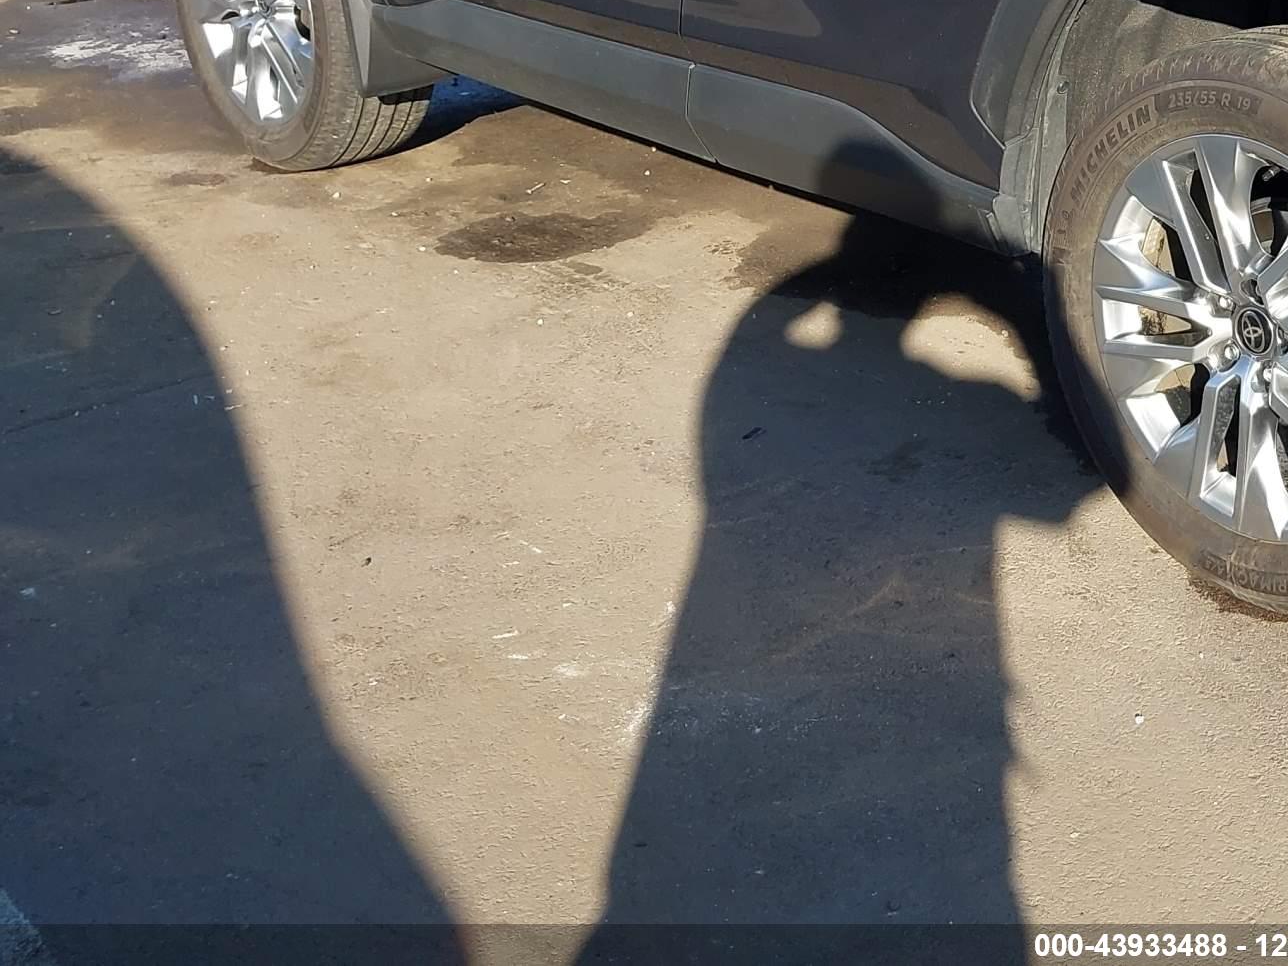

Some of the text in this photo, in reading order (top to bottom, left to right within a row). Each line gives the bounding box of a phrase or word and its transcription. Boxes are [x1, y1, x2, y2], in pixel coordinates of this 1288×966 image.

[1167, 90, 1251, 111] 235/55 R 19
[1070, 104, 1151, 203] MICHELIN
